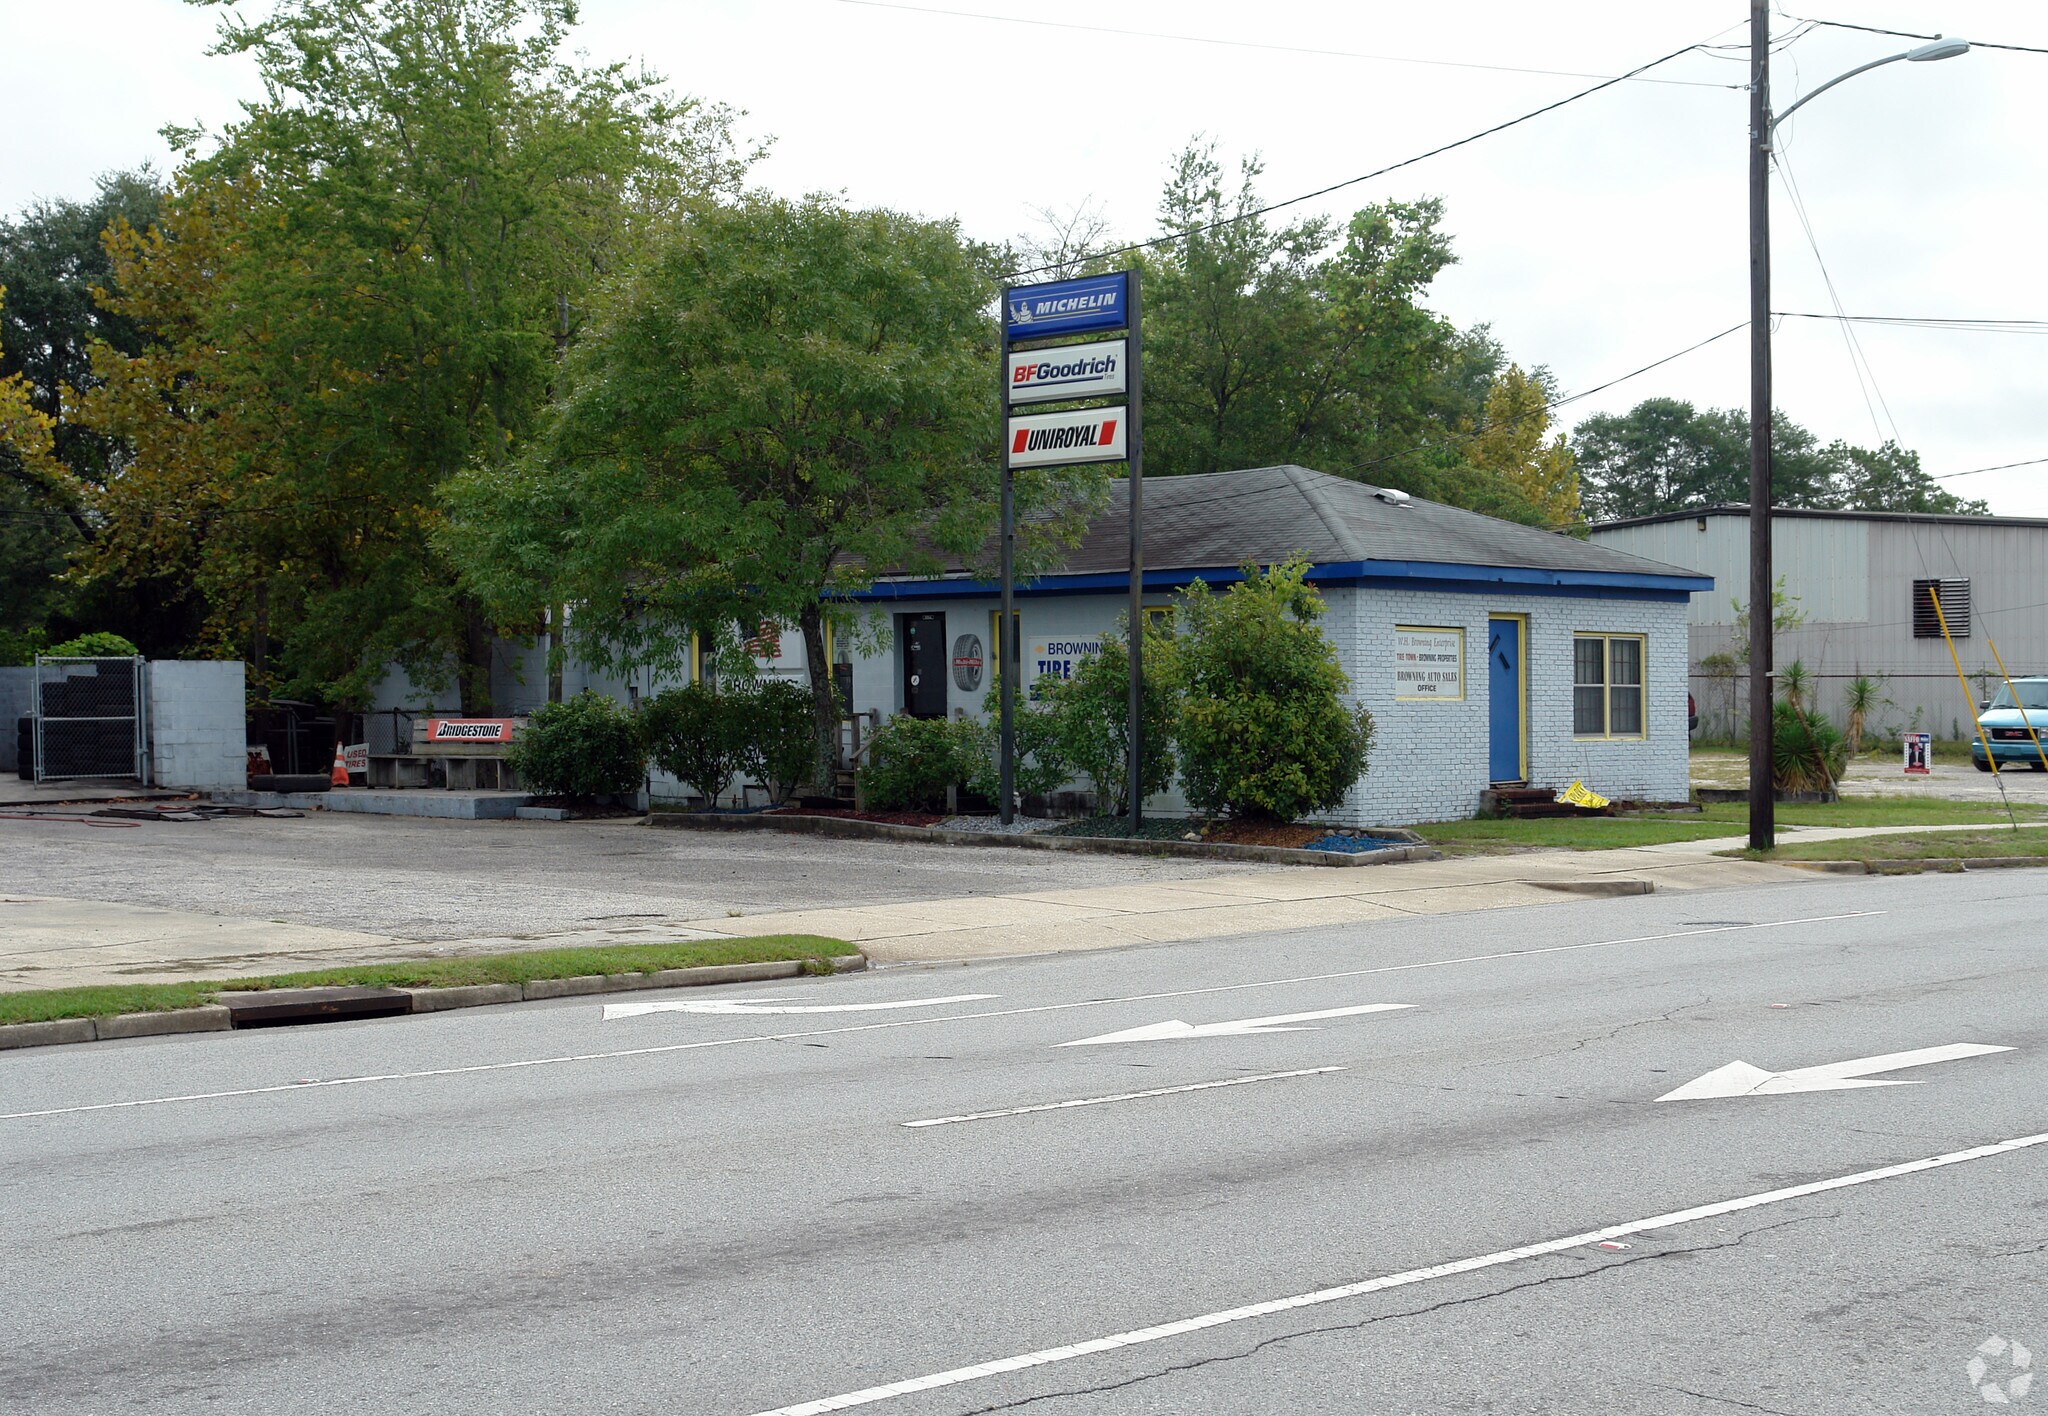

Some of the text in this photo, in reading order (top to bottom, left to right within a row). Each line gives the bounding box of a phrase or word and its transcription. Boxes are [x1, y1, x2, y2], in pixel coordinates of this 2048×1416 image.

[1035, 292, 1117, 315] MICHELIN
[1013, 355, 1116, 383] BFGoodrich
[1027, 425, 1098, 451] UNIROYAL
[1048, 642, 1103, 655] BROWNIN
[1411, 637, 1432, 651] Browning
[1418, 653, 1437, 662] BROWNING
[1038, 660, 1071, 679] TIRE
[1397, 671, 1458, 682] BROWNING AUTO SALES
[1417, 684, 1437, 692] OFFICE
[437, 722, 502, 737] BRIDGESTONE
[347, 748, 367, 758] USED
[345, 759, 366, 768] TIRES
